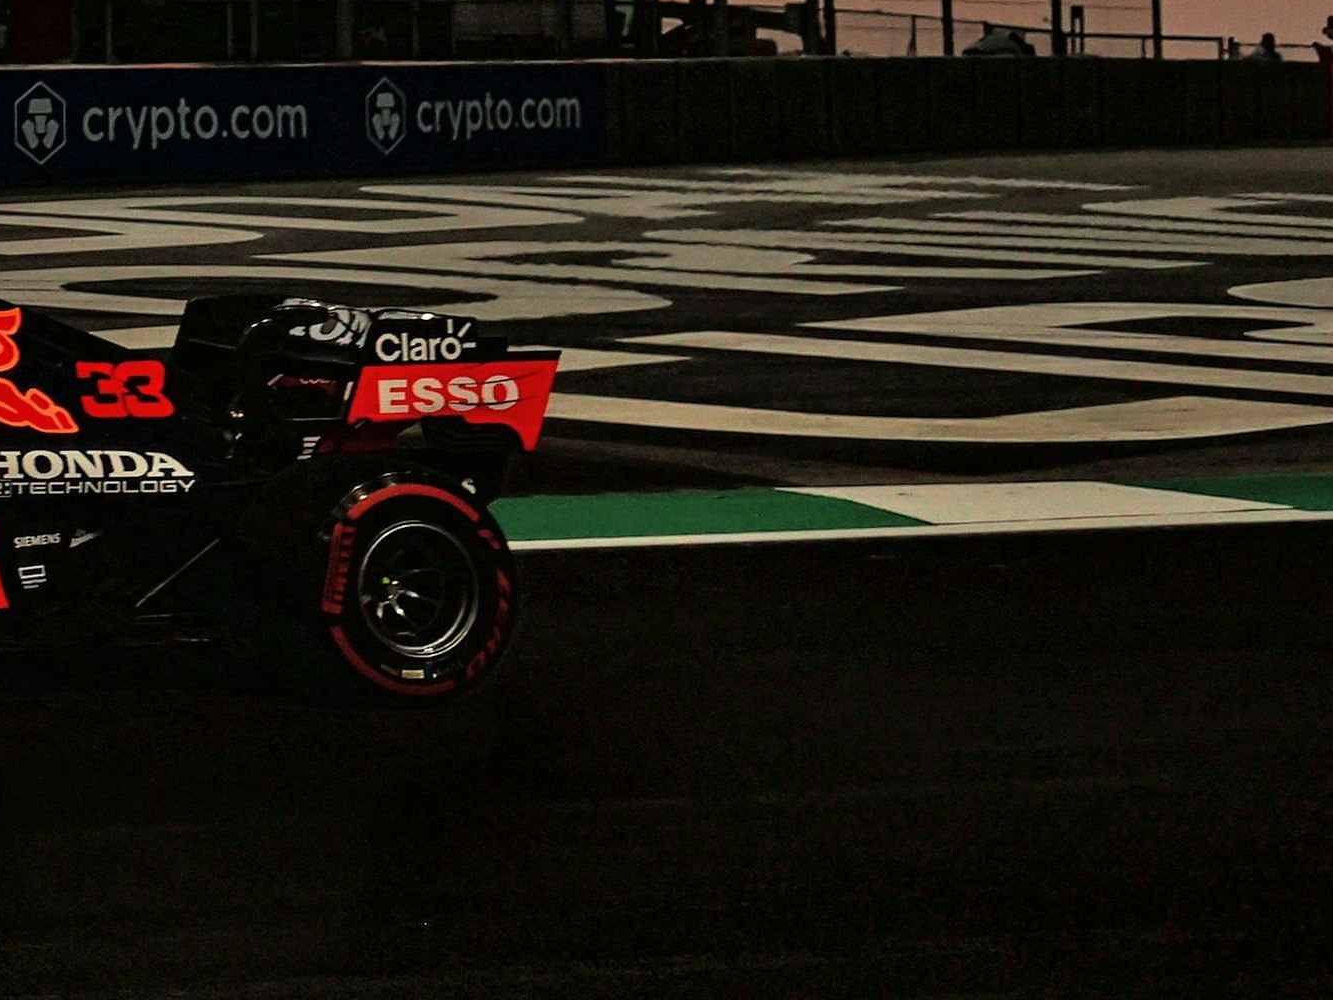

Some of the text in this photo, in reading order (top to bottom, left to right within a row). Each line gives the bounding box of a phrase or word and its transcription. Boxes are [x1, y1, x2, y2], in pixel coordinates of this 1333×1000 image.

[81, 96, 308, 151] crypto.com
[415, 91, 581, 141] crypto.com
[375, 330, 464, 363] Claro
[74, 359, 176, 419] 33
[377, 374, 520, 414] ESSO
